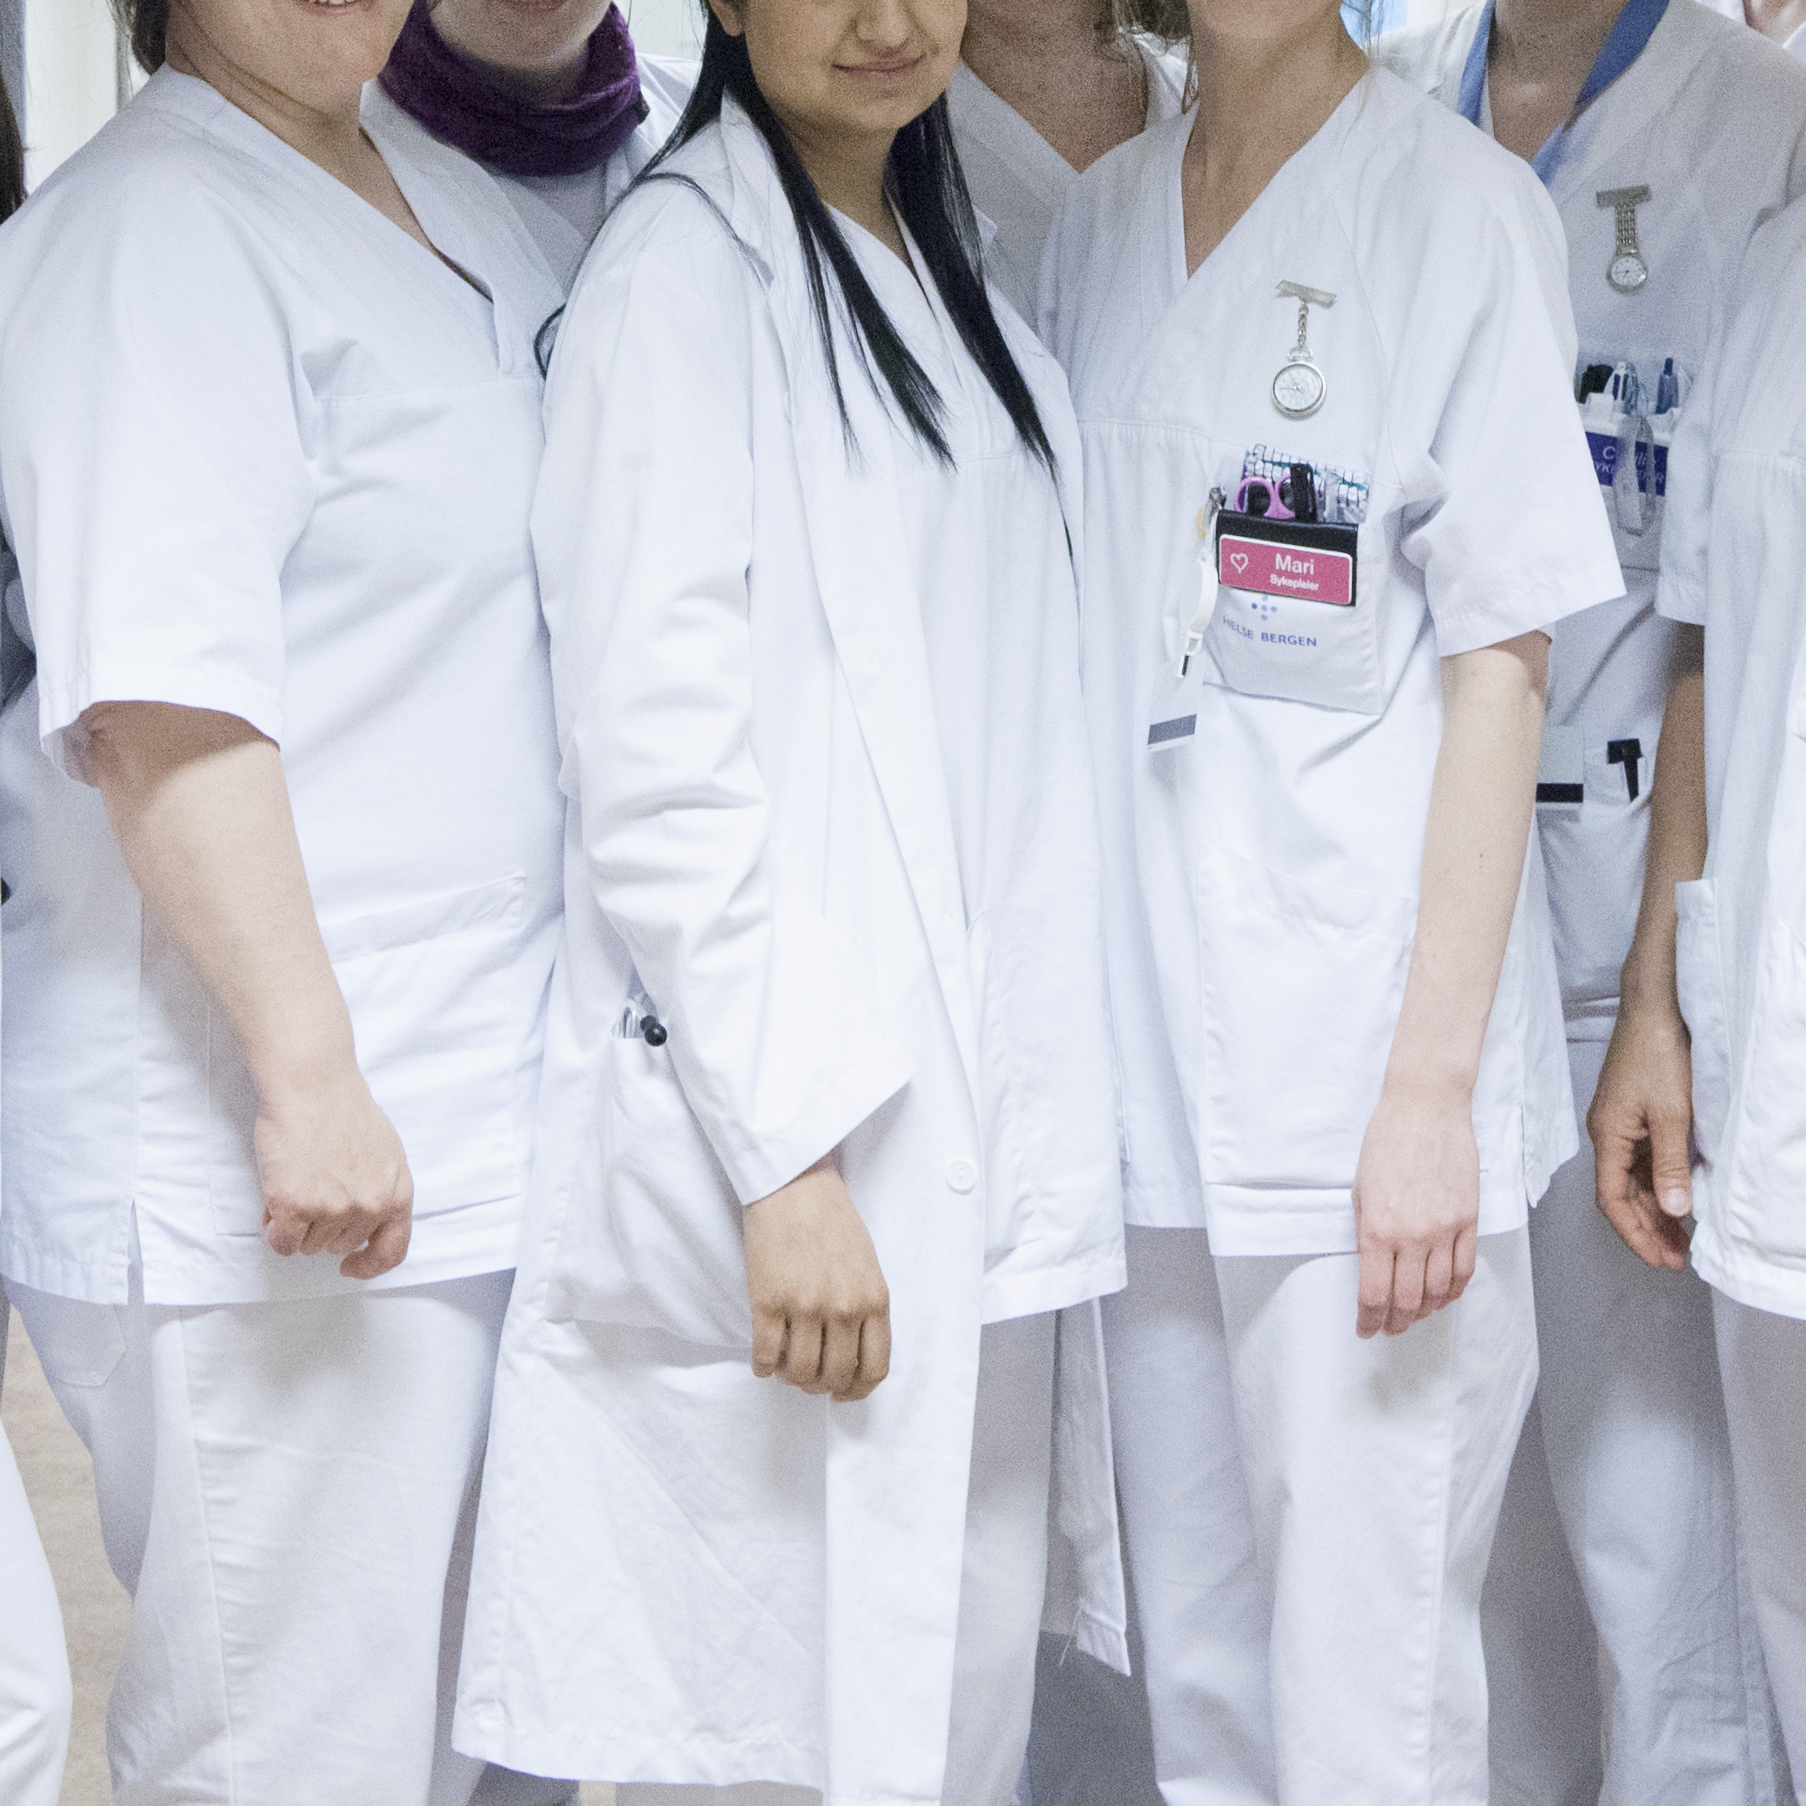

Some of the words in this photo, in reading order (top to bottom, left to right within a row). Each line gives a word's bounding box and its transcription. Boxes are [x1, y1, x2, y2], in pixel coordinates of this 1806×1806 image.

[1274, 553, 1314, 573] Mari
[1270, 574, 1318, 590] Sykepleier
[1222, 616, 1254, 639] HELSE
[1260, 631, 1317, 646] BERGEN
